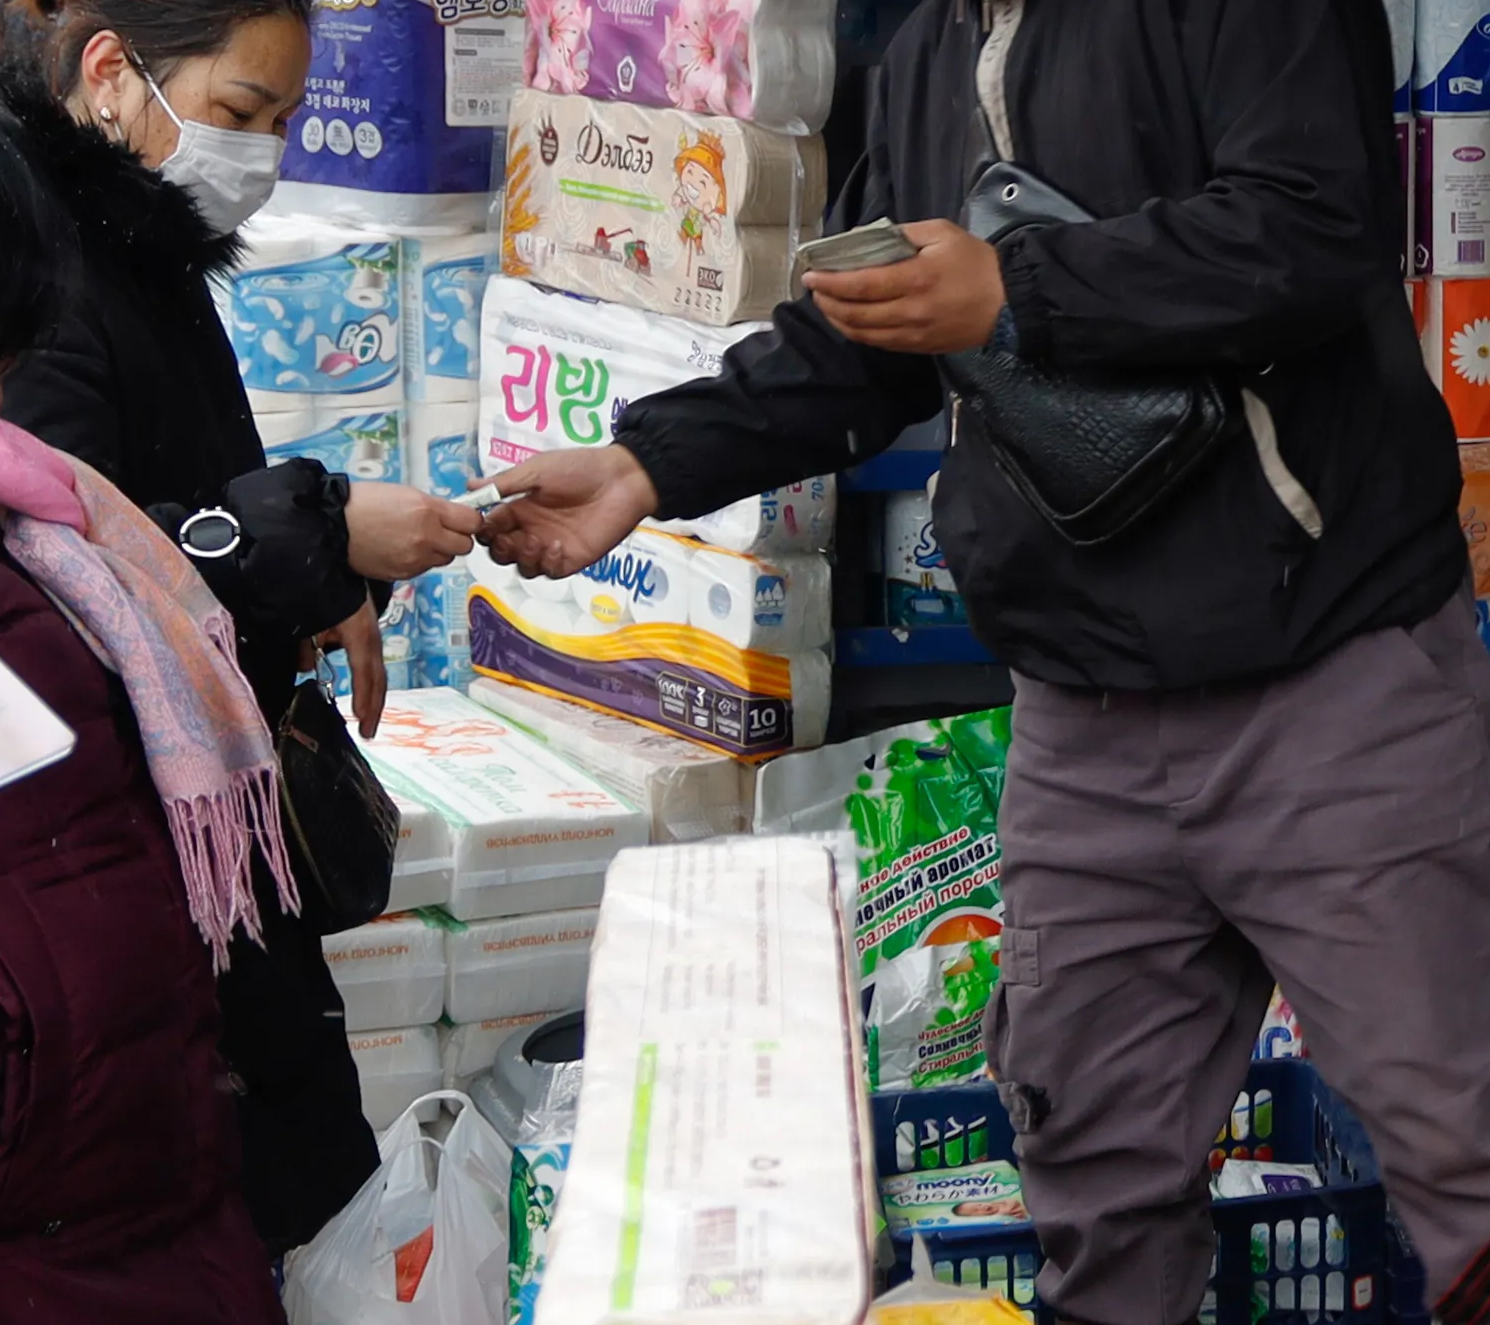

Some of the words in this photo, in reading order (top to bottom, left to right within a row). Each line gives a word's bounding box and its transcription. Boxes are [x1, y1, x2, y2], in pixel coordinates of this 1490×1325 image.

[575, 120, 653, 174] Дэлбээ
[500, 343, 611, 445] 리빙
[576, 550, 656, 599] leenex
[749, 707, 777, 729] 10
[892, 826, 969, 876] действие
[856, 871, 925, 928] нечный
[927, 836, 998, 885] аромат
[856, 893, 935, 954] ральный
[940, 862, 1001, 905] порош
[918, 1022, 983, 1059] Солнечны
[895, 1186, 1002, 1206] やわらか素材
[916, 1172, 992, 1190] moony
